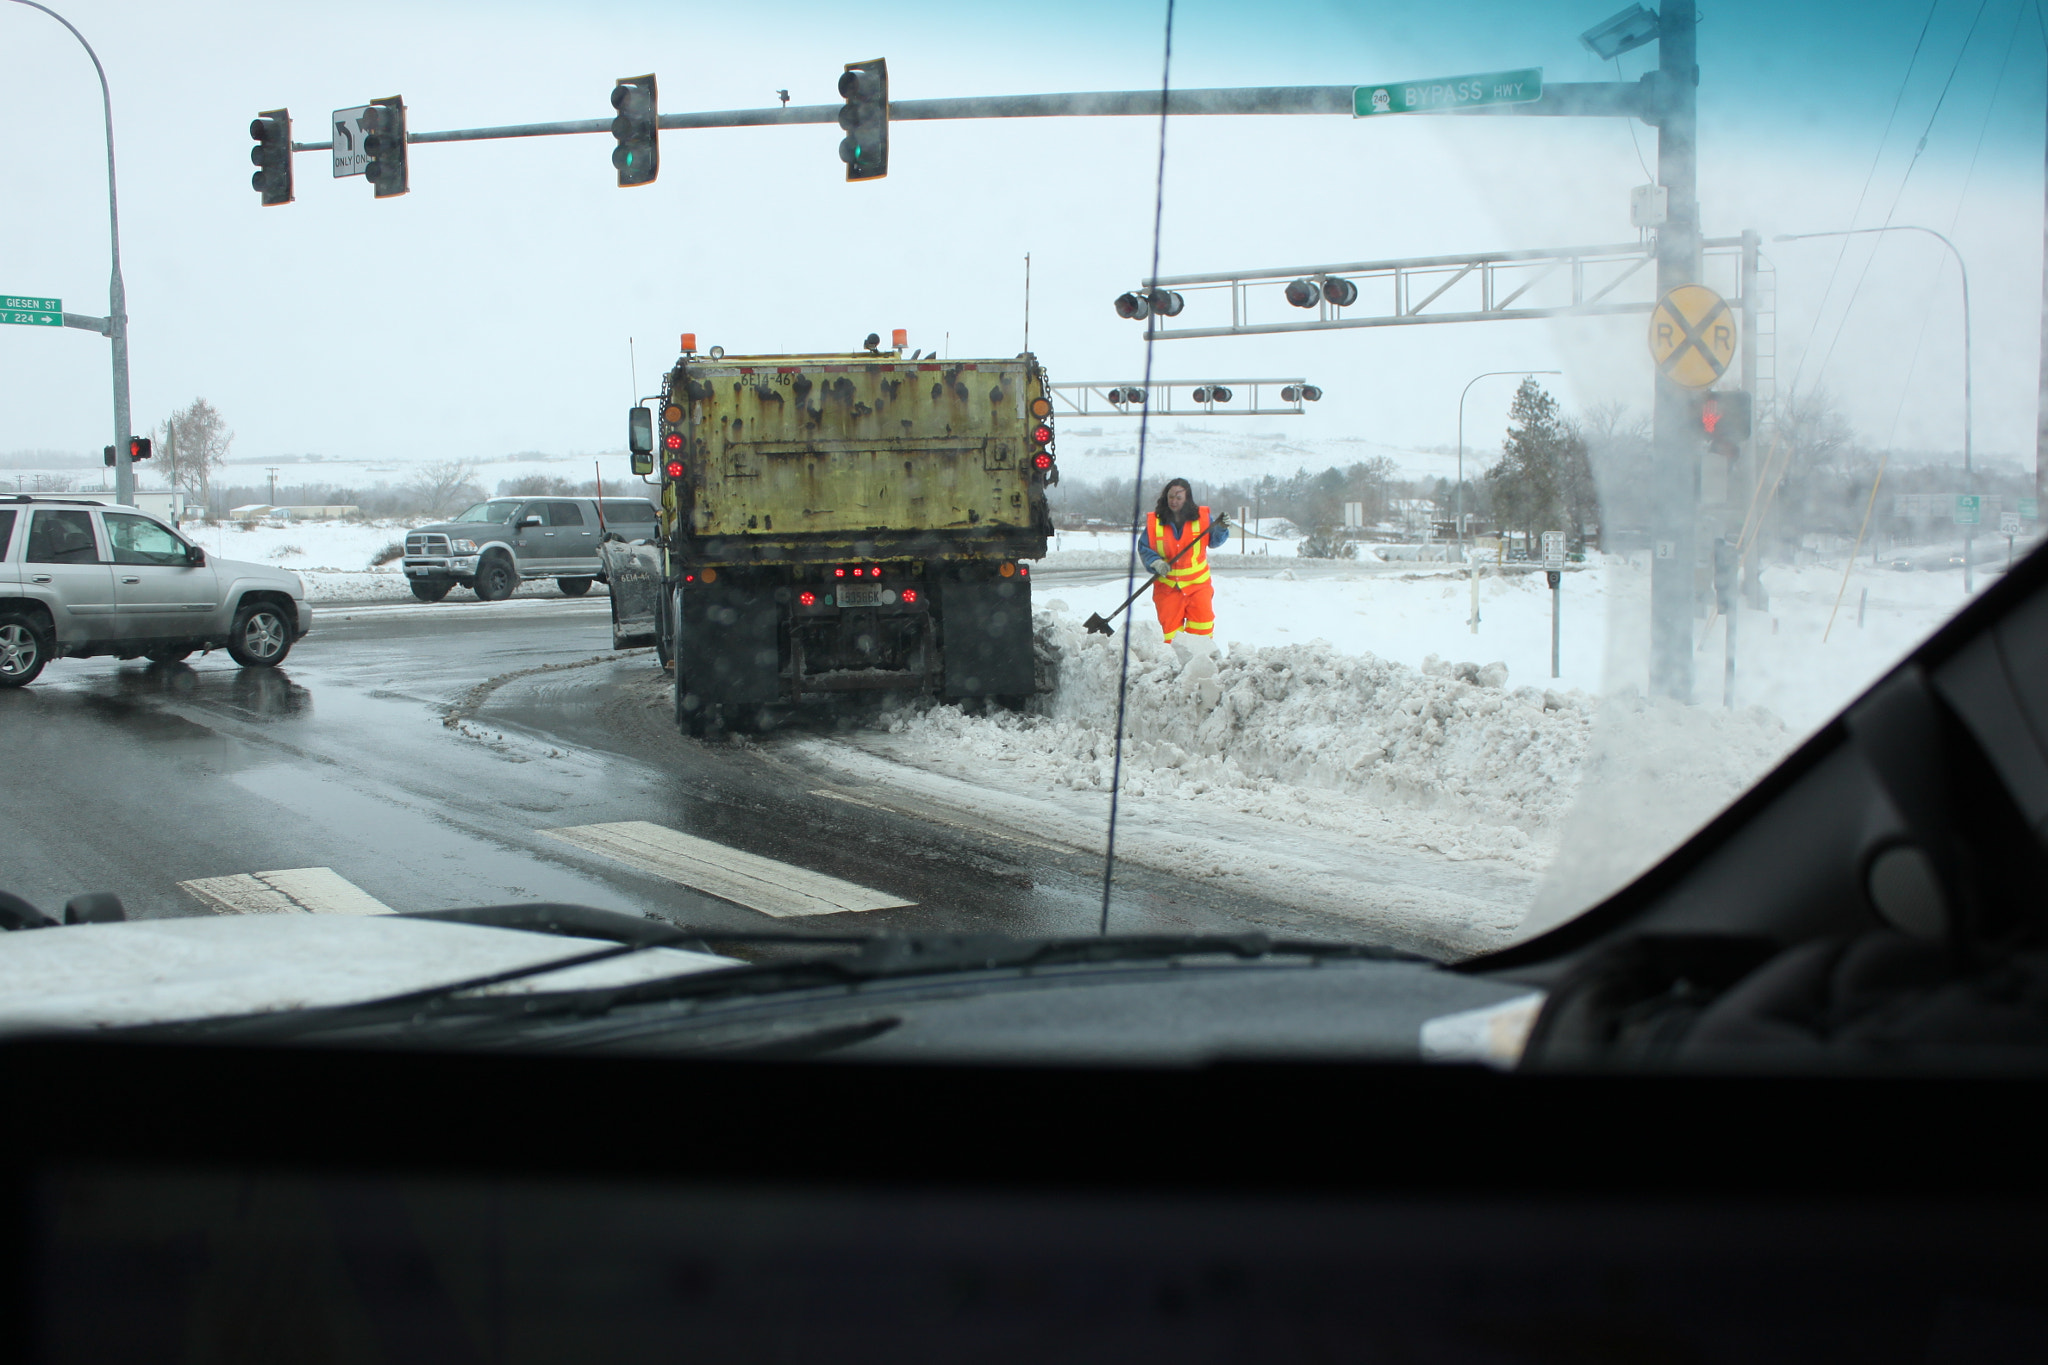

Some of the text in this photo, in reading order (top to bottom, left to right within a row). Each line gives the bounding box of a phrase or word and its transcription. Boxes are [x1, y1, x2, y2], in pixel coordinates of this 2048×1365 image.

[1373, 81, 1523, 107] 240 BYPASS HWY
[335, 156, 353, 168] ONLY
[355, 154, 371, 165] ONL
[6, 298, 56, 309] GIESEN ST
[14, 313, 34, 323] 224
[741, 373, 791, 386] 6E14-46
[2002, 524, 2018, 533] 40
